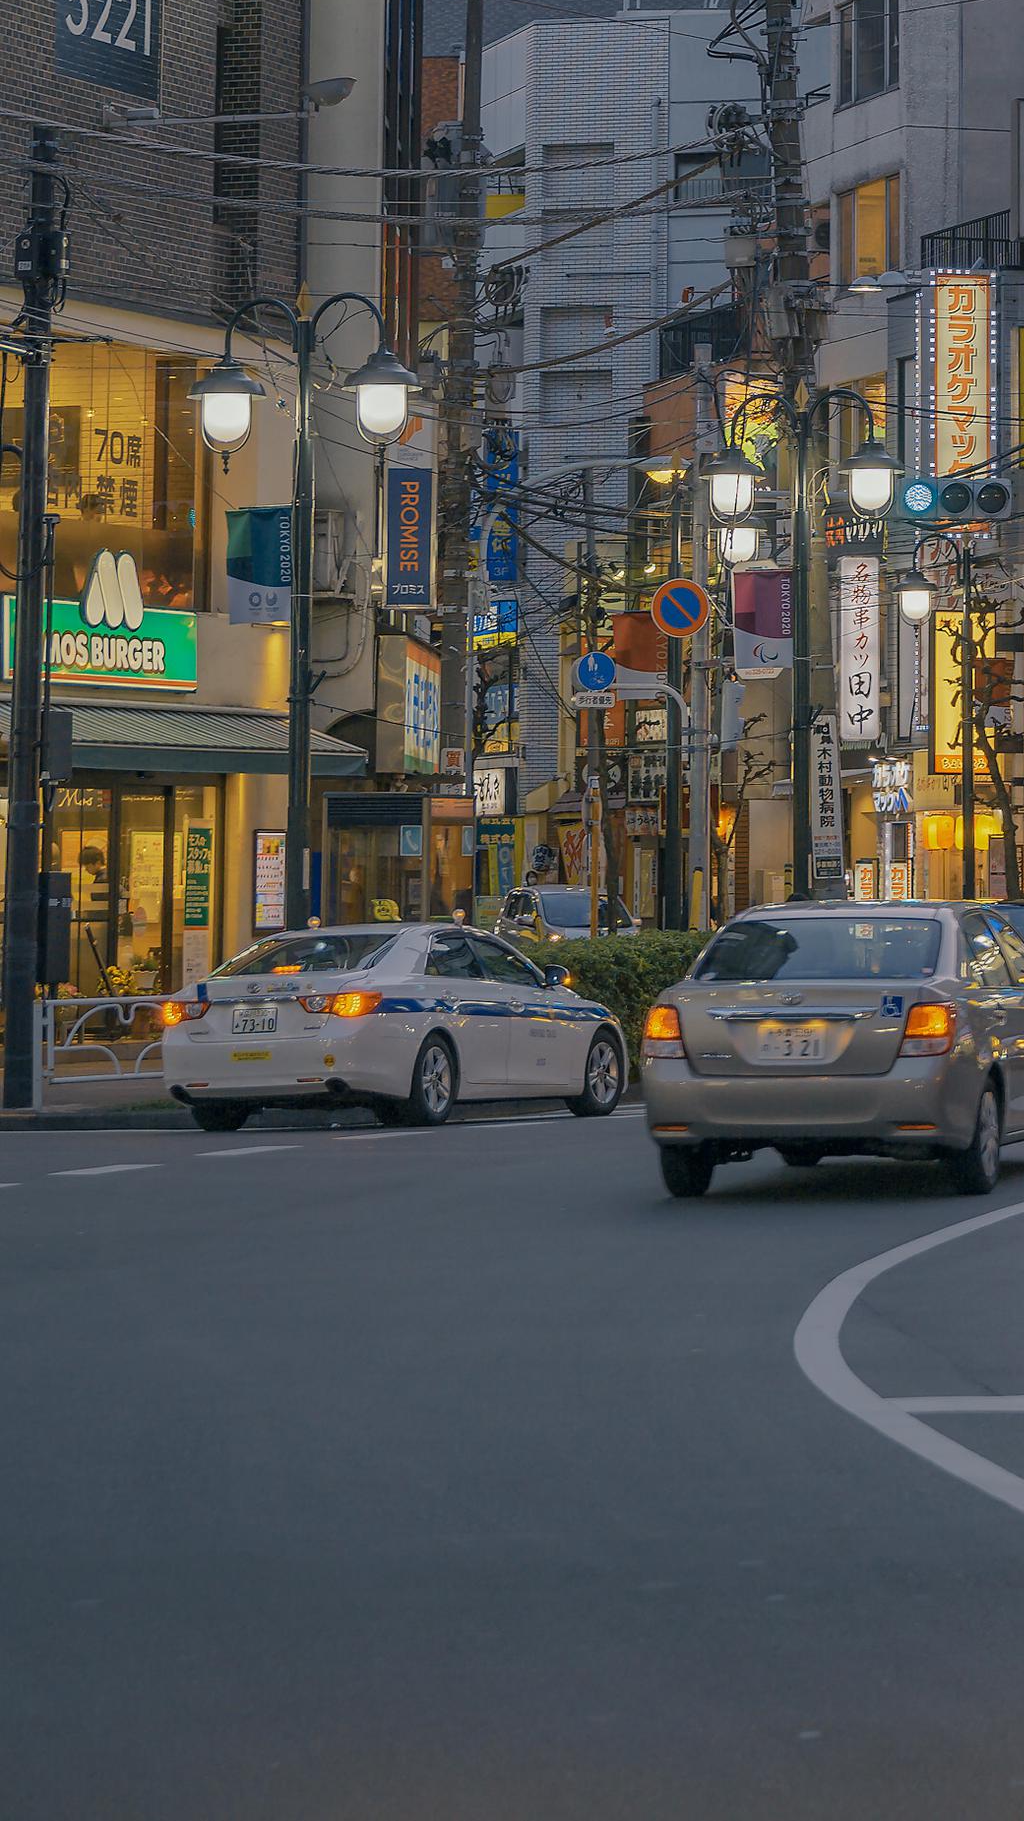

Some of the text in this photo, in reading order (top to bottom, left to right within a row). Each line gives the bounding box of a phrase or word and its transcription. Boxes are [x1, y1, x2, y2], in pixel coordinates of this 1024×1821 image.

[95, 429, 142, 468] 70席
[96, 475, 138, 517] 禁煙
[400, 481, 420, 572] PROMISE
[280, 514, 292, 582] TOKYO 2020
[392, 583, 425, 595] プロミス
[780, 578, 792, 635] TOKYO 2020
[90, 633, 166, 674] BURGER
[847, 561, 874, 736] 名物串カツ田中
[577, 694, 613, 706] 歩行者優先
[816, 746, 836, 828] 木村動物病院
[242, 1018, 276, 1032] 73-10
